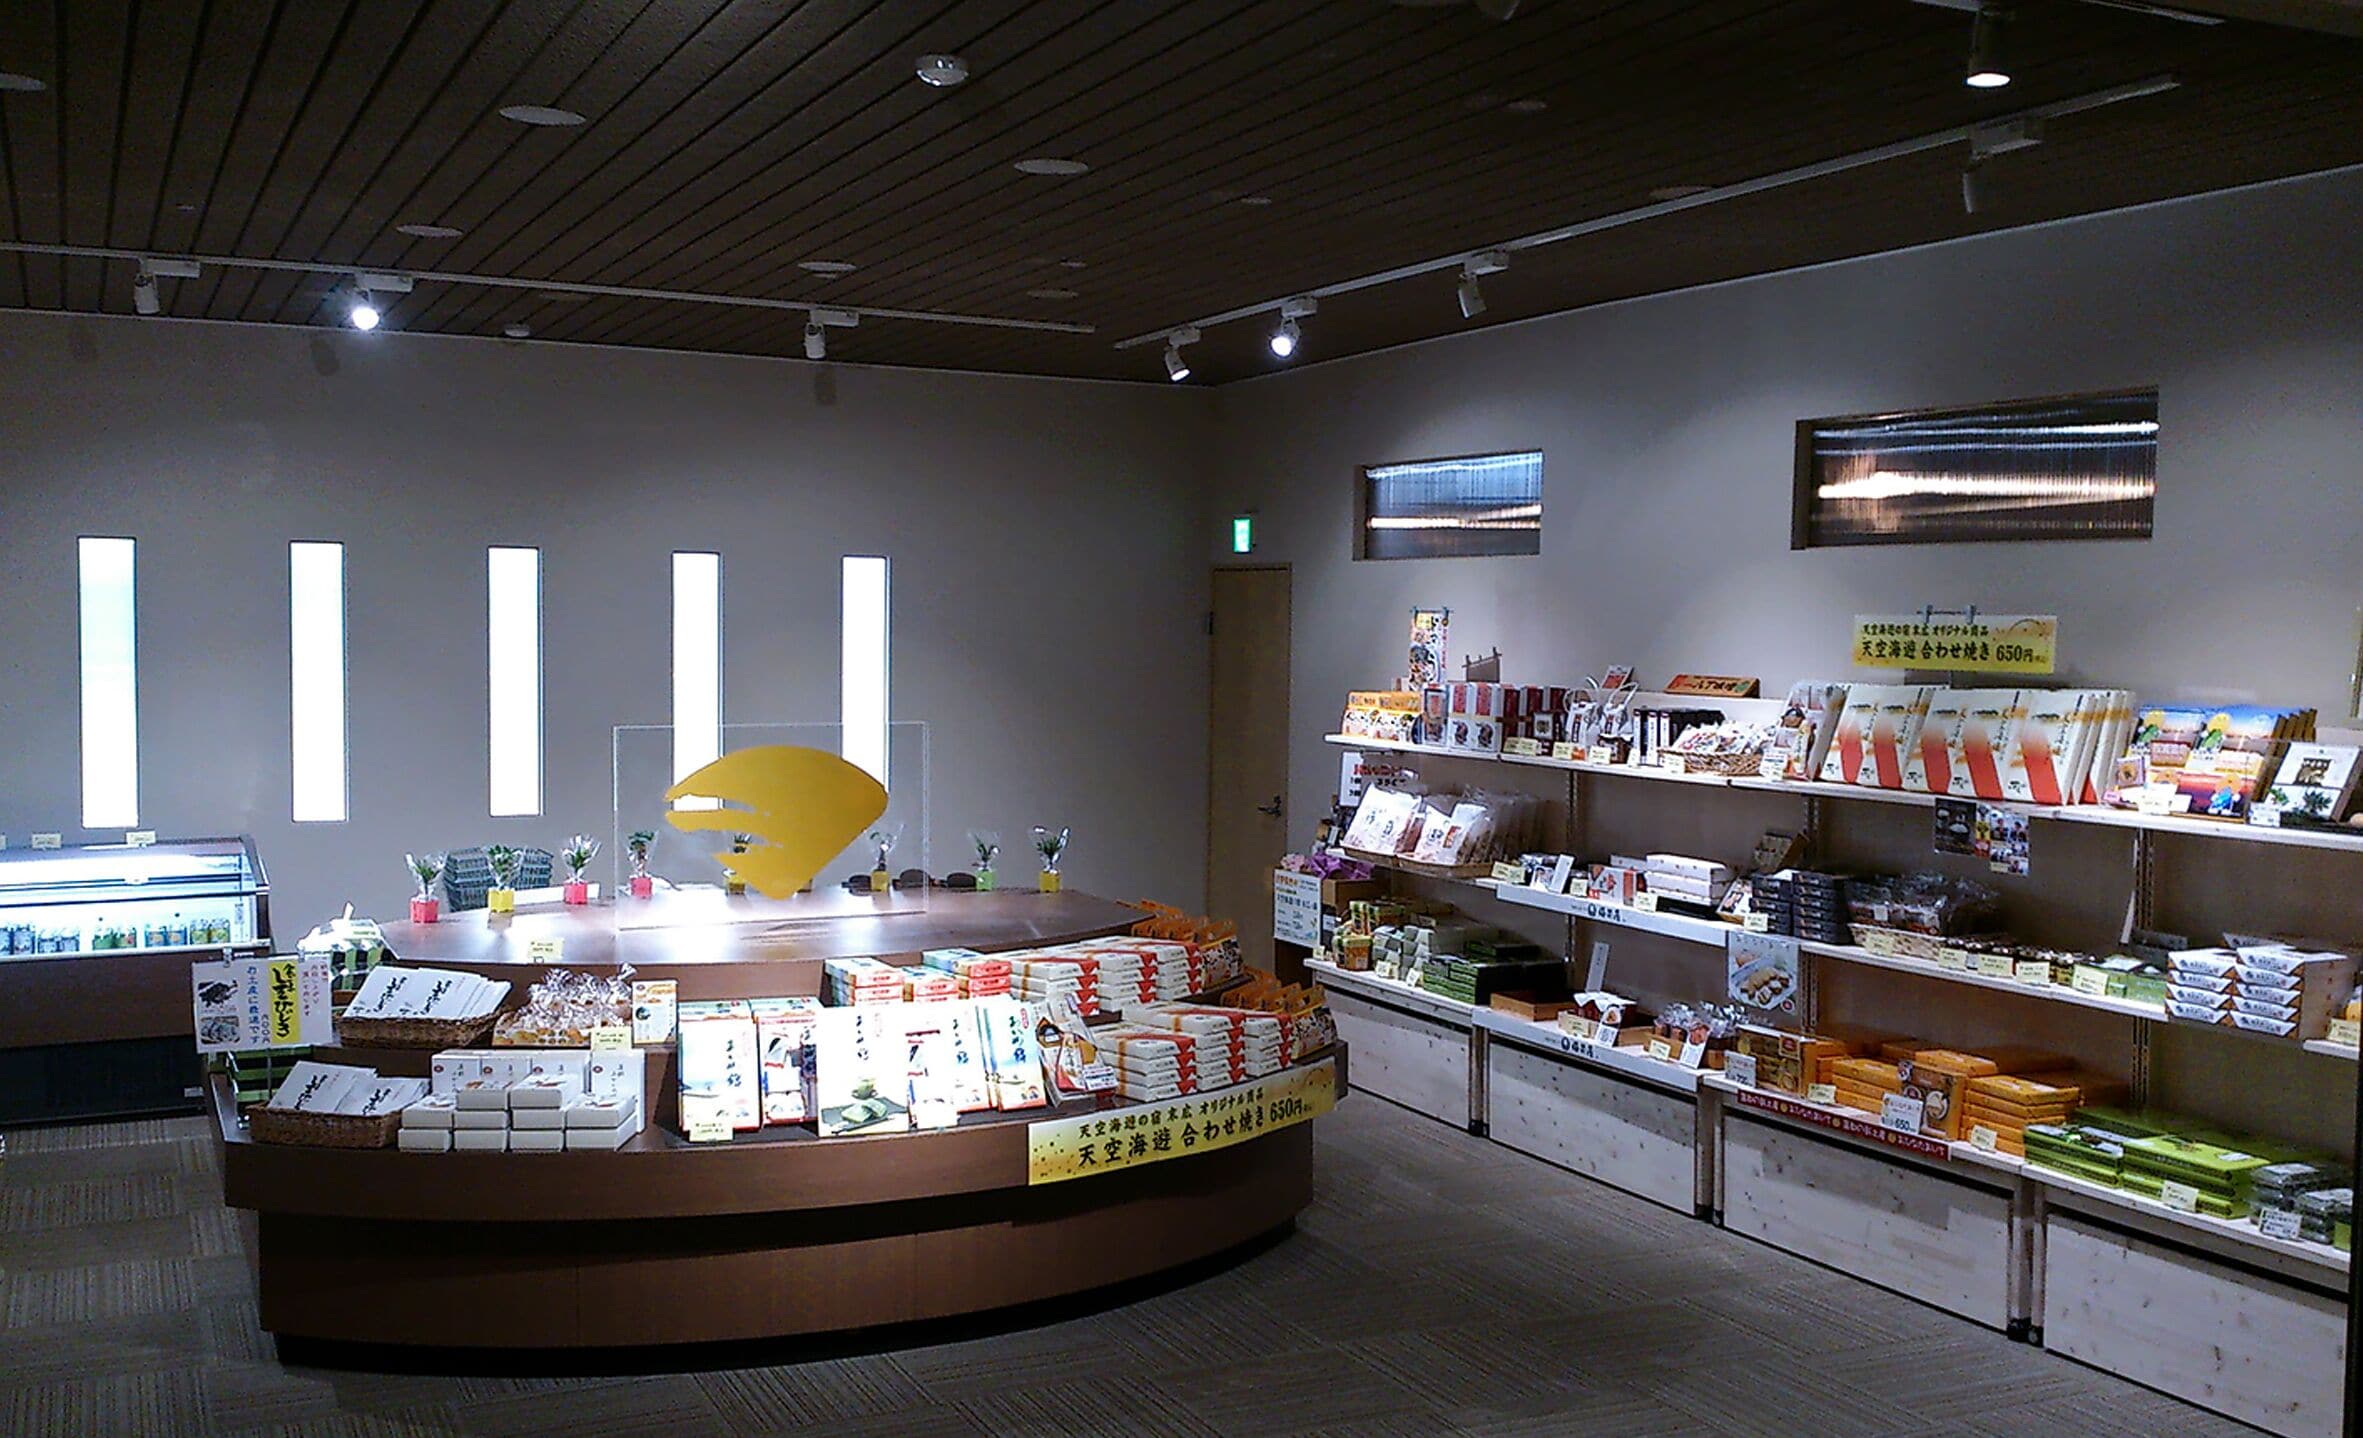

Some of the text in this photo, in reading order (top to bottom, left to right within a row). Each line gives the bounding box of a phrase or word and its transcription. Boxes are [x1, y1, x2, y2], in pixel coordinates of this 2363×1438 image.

[1861, 639, 1916, 660] 天空海遊
[1921, 640, 1990, 662] 合わせ焼き
[1996, 644, 2033, 663] 650円
[1078, 1109, 1162, 1140] 天空海遊の宿
[1078, 1099, 1302, 1168] 天空海遊 合わせ焼き 650円
